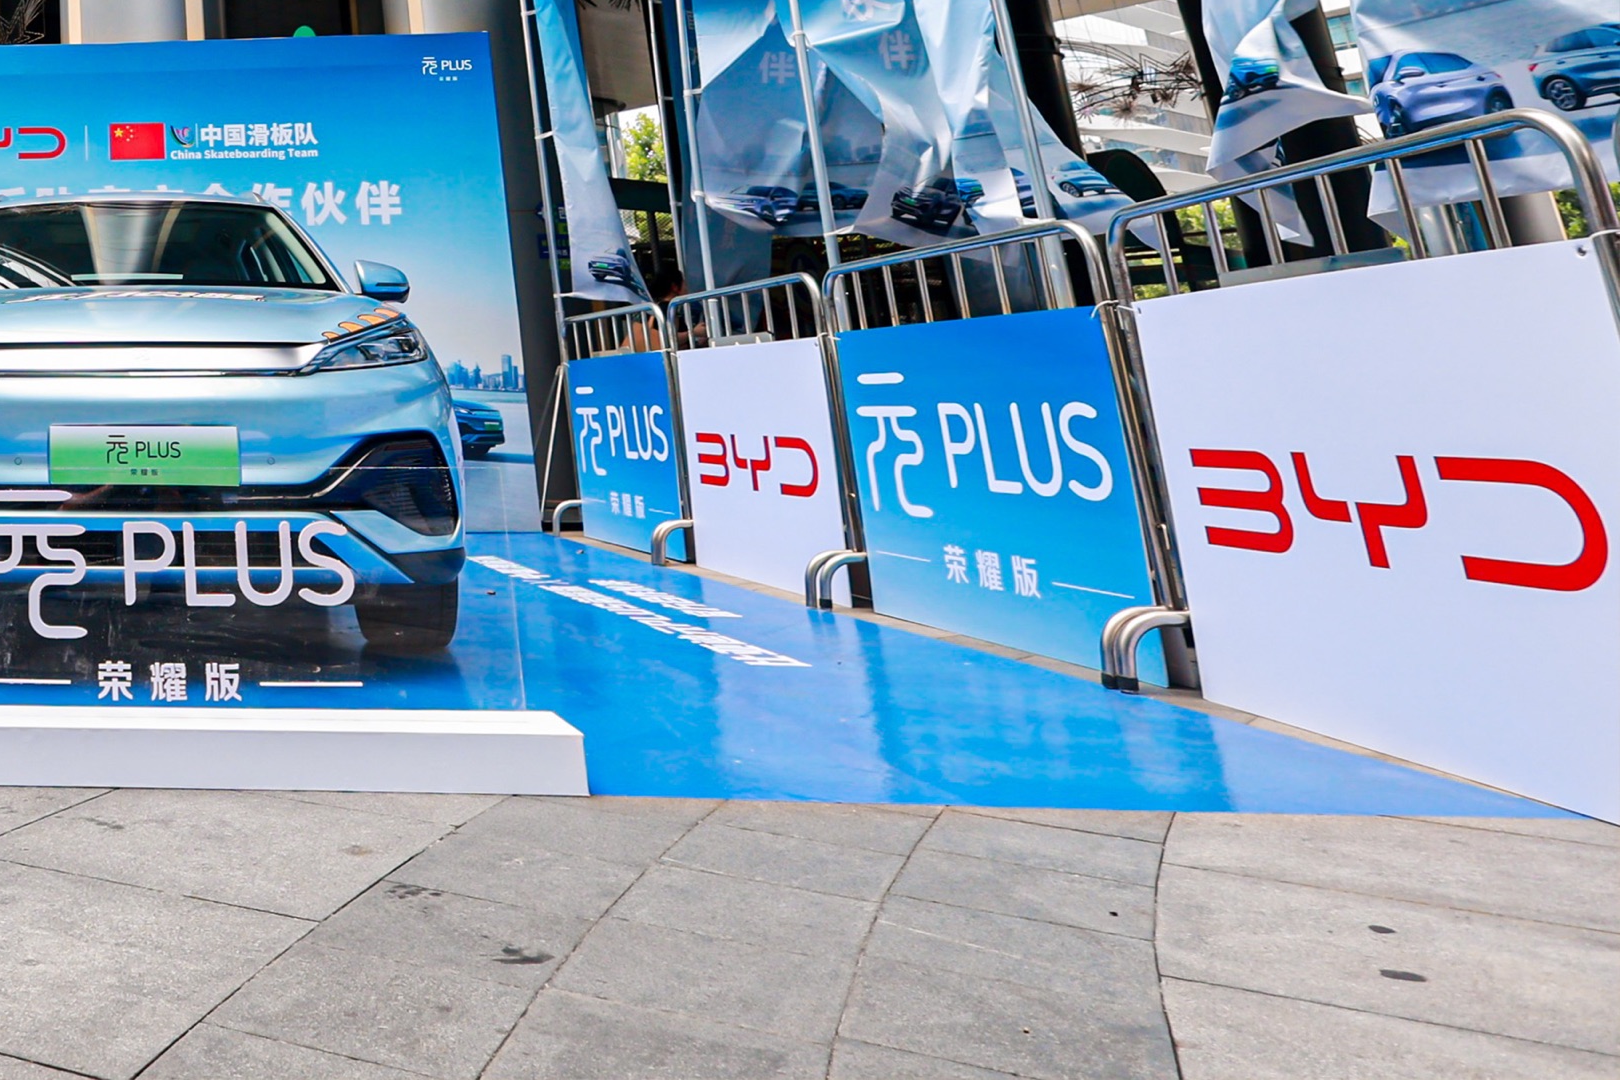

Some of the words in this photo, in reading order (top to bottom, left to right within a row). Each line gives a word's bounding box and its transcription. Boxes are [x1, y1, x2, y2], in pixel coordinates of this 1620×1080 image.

[441, 59, 473, 71] PLUS
[170, 149, 202, 161] China
[204, 148, 284, 163] Skateboarding
[287, 148, 319, 160] Team
[200, 122, 319, 148] 中国滑板队
[135, 441, 181, 459] PLUS
[606, 404, 669, 463] PLUS
[937, 401, 1114, 502] PLUS
[695, 432, 820, 498] BYD
[1189, 447, 1608, 592] BYD
[123, 520, 356, 608] PLUS
[942, 544, 1042, 600] 荣耀版
[96, 660, 243, 702] 荣耀版
